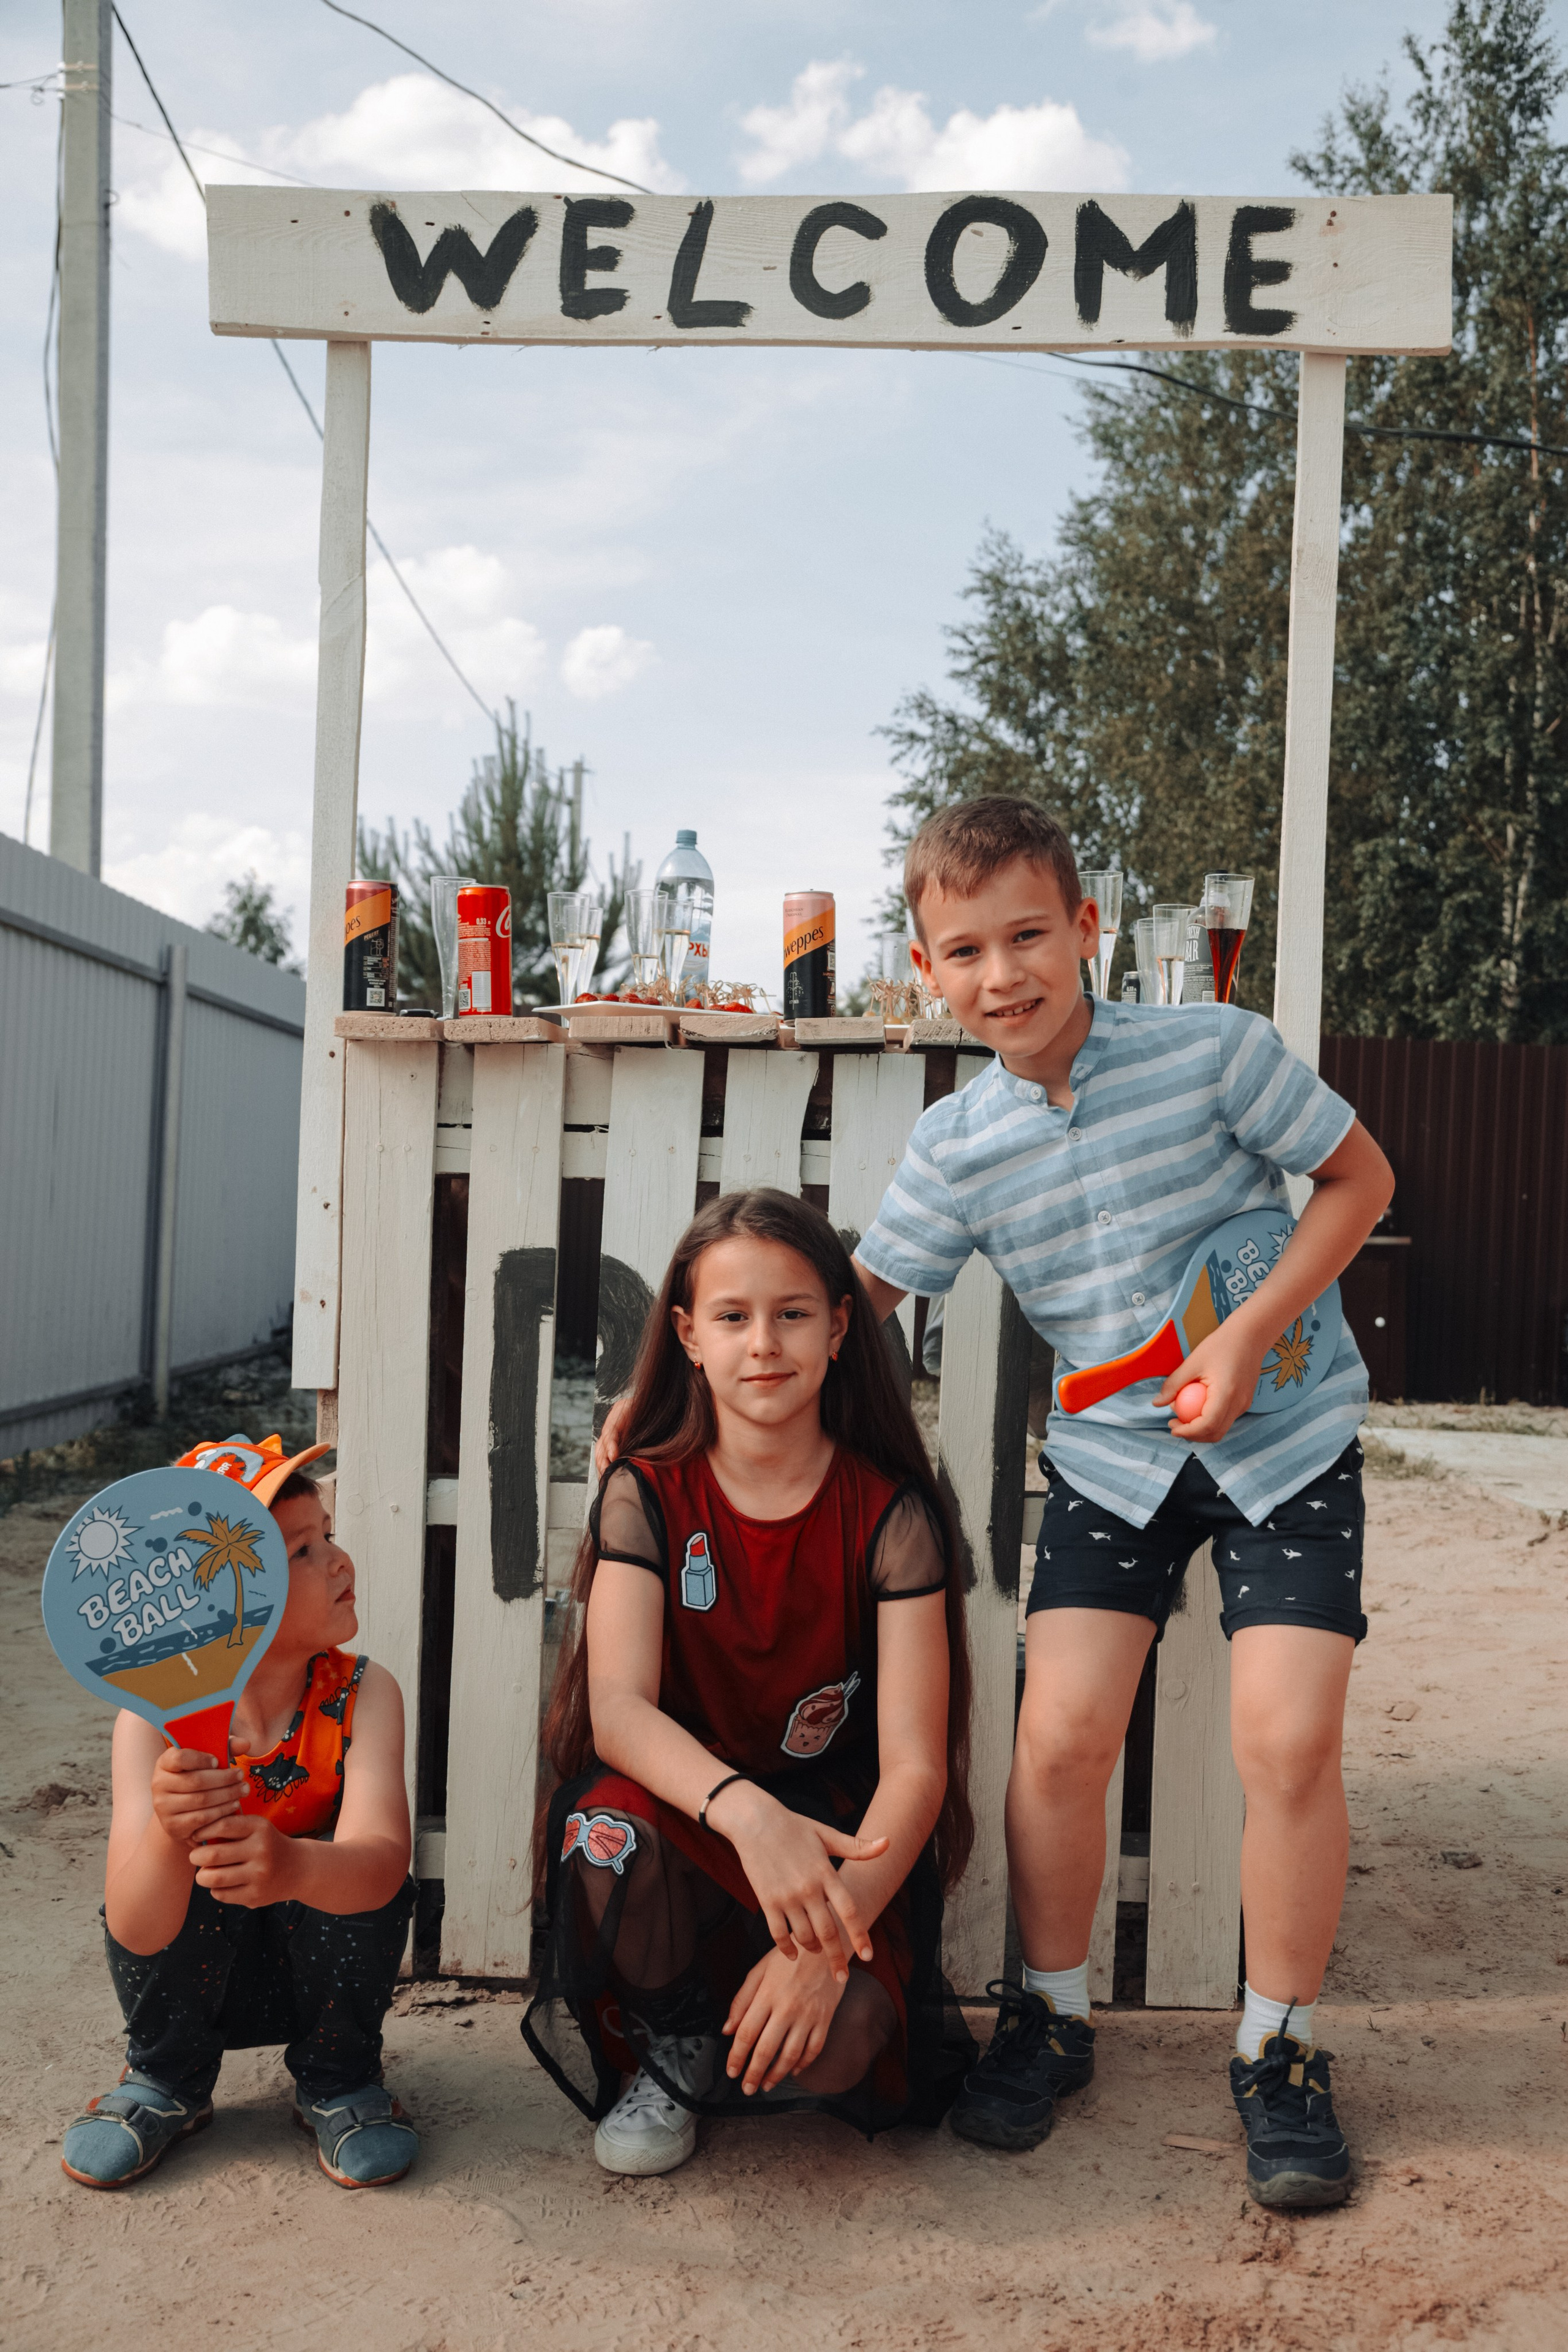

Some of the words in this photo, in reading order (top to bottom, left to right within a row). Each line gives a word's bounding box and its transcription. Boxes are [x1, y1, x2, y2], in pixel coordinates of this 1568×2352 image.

[369, 196, 1297, 335] WELCOME
[1185, 940, 1199, 962] BAR
[77, 1547, 194, 1630] BEACH
[111, 1585, 200, 1648] BALL
